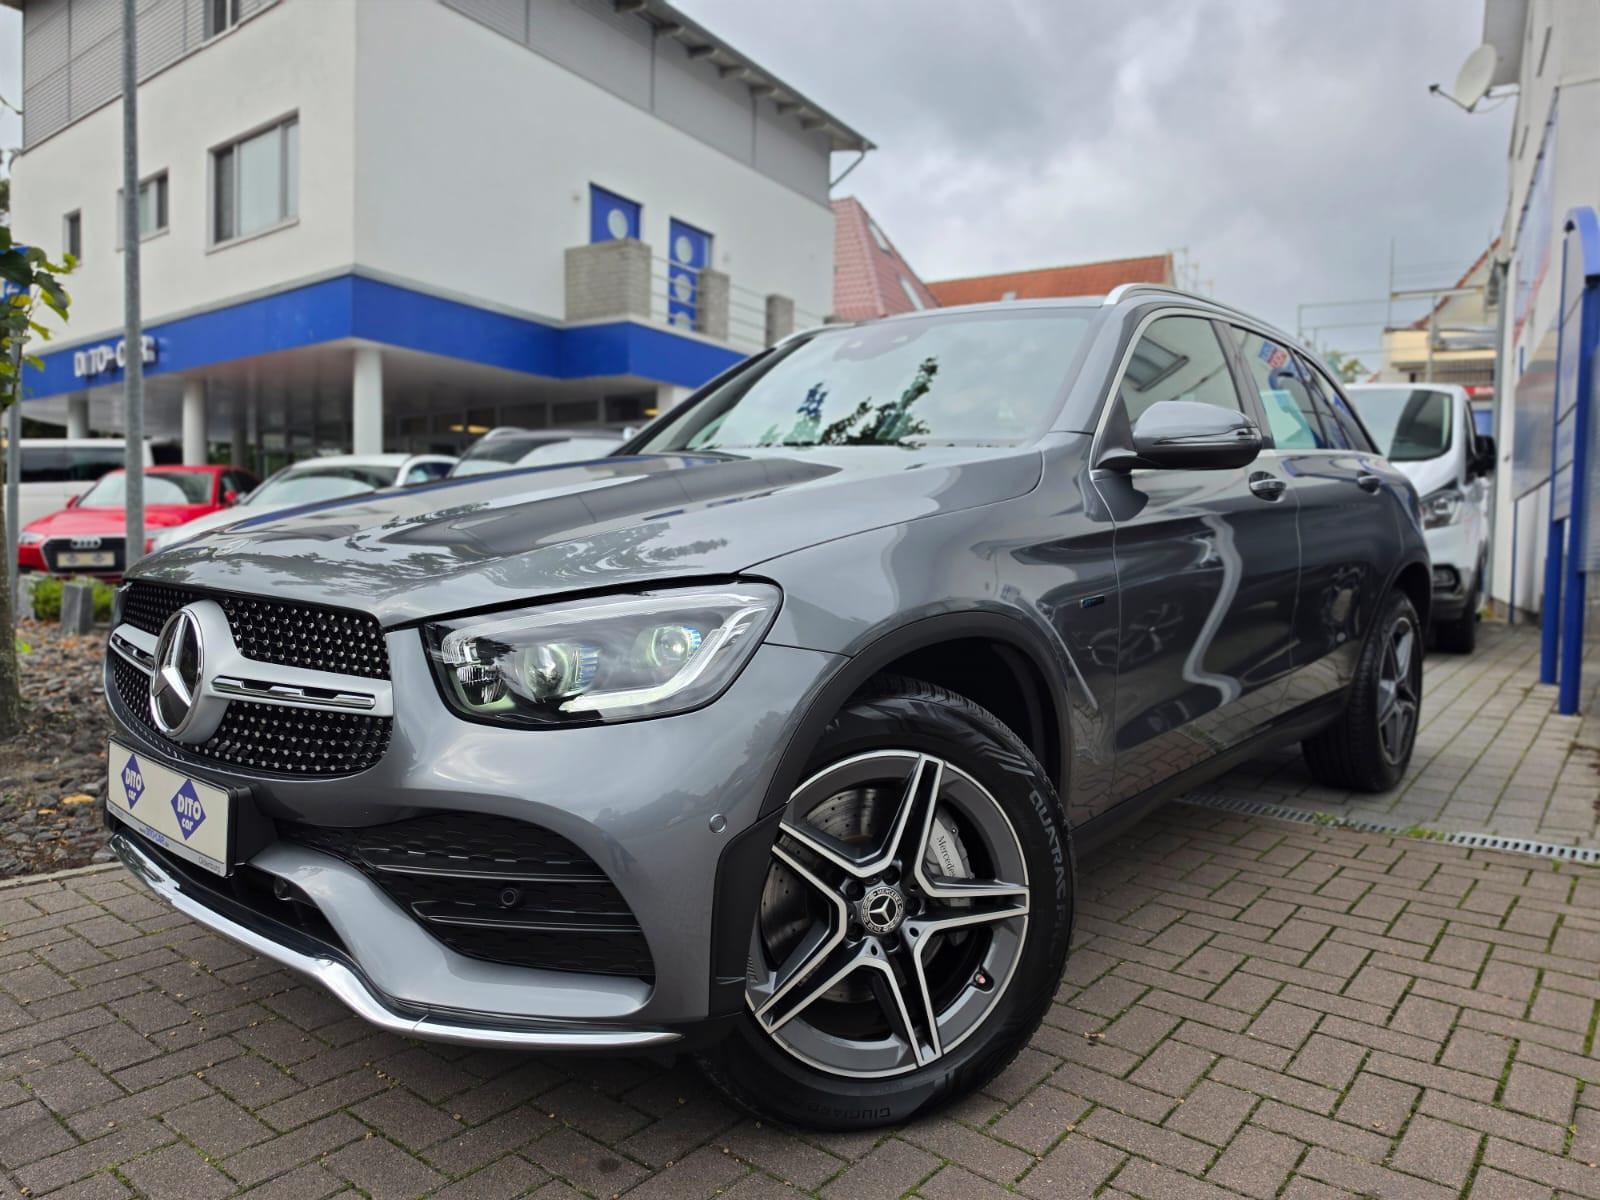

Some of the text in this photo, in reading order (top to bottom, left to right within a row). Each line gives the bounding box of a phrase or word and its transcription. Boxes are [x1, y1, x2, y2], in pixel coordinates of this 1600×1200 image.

[125, 767, 141, 791] DITO
[177, 793, 201, 820] DITO
[181, 817, 193, 830] car
[1029, 789, 1067, 900] QUATRAC
